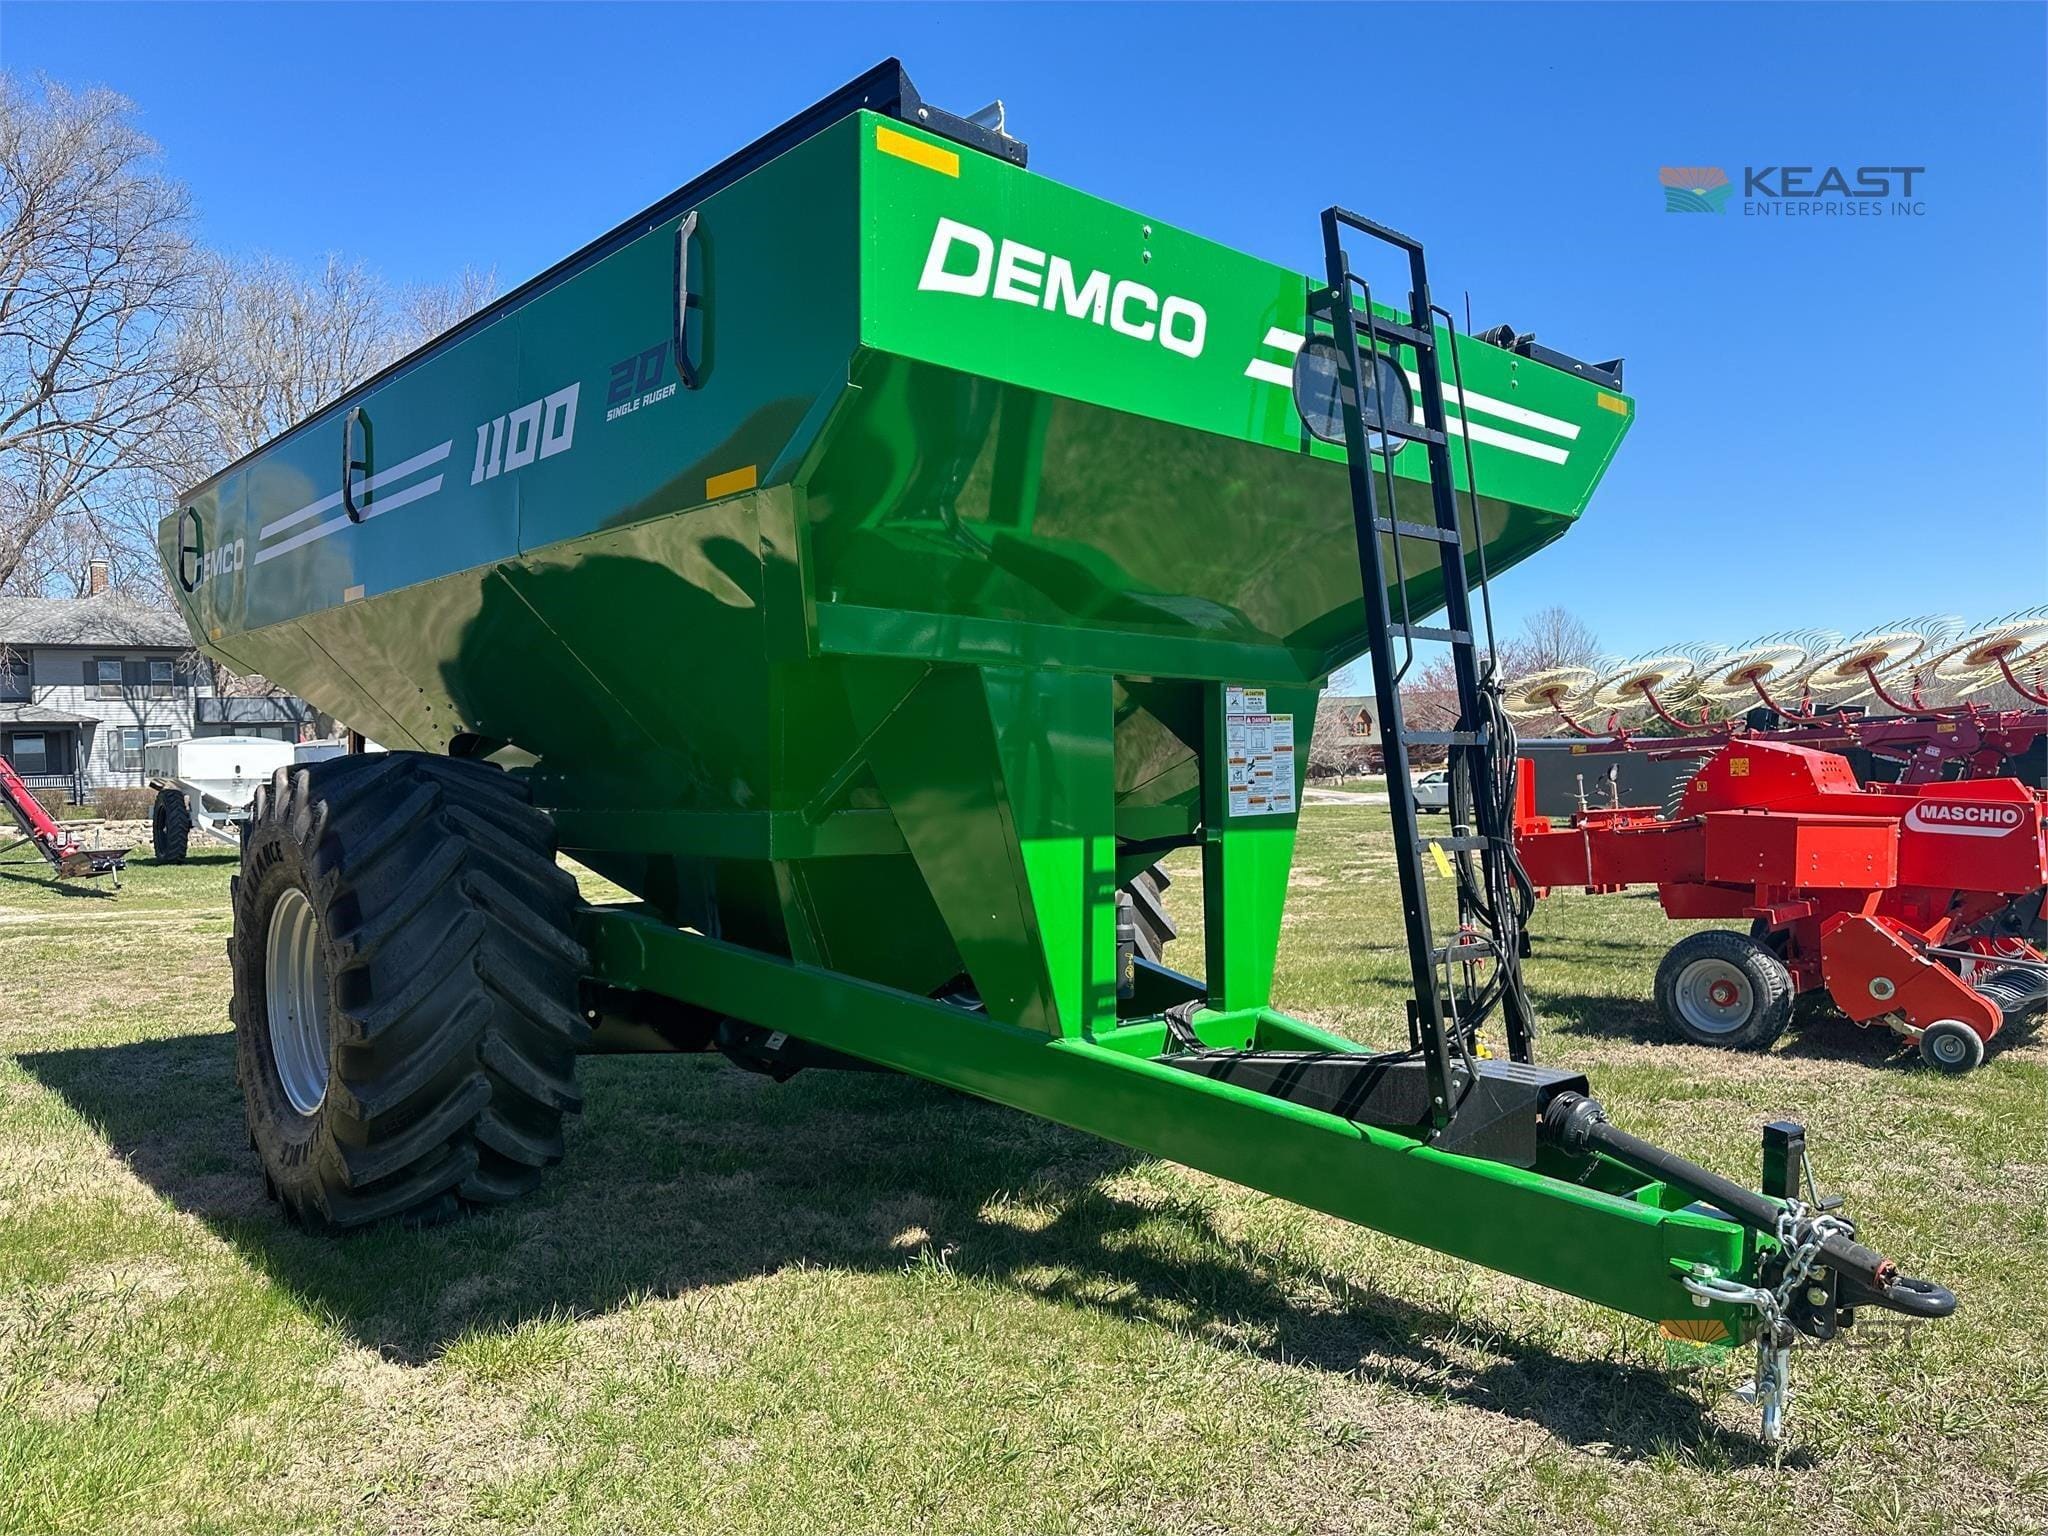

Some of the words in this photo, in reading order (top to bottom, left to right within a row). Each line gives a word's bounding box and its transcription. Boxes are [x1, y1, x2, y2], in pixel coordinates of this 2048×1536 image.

[917, 216, 1208, 359] DEMCO
[470, 381, 581, 486] 1100
[606, 398, 641, 422] SINGLE
[642, 382, 677, 407] AUGER
[1920, 805, 2018, 824] MASCHIO
